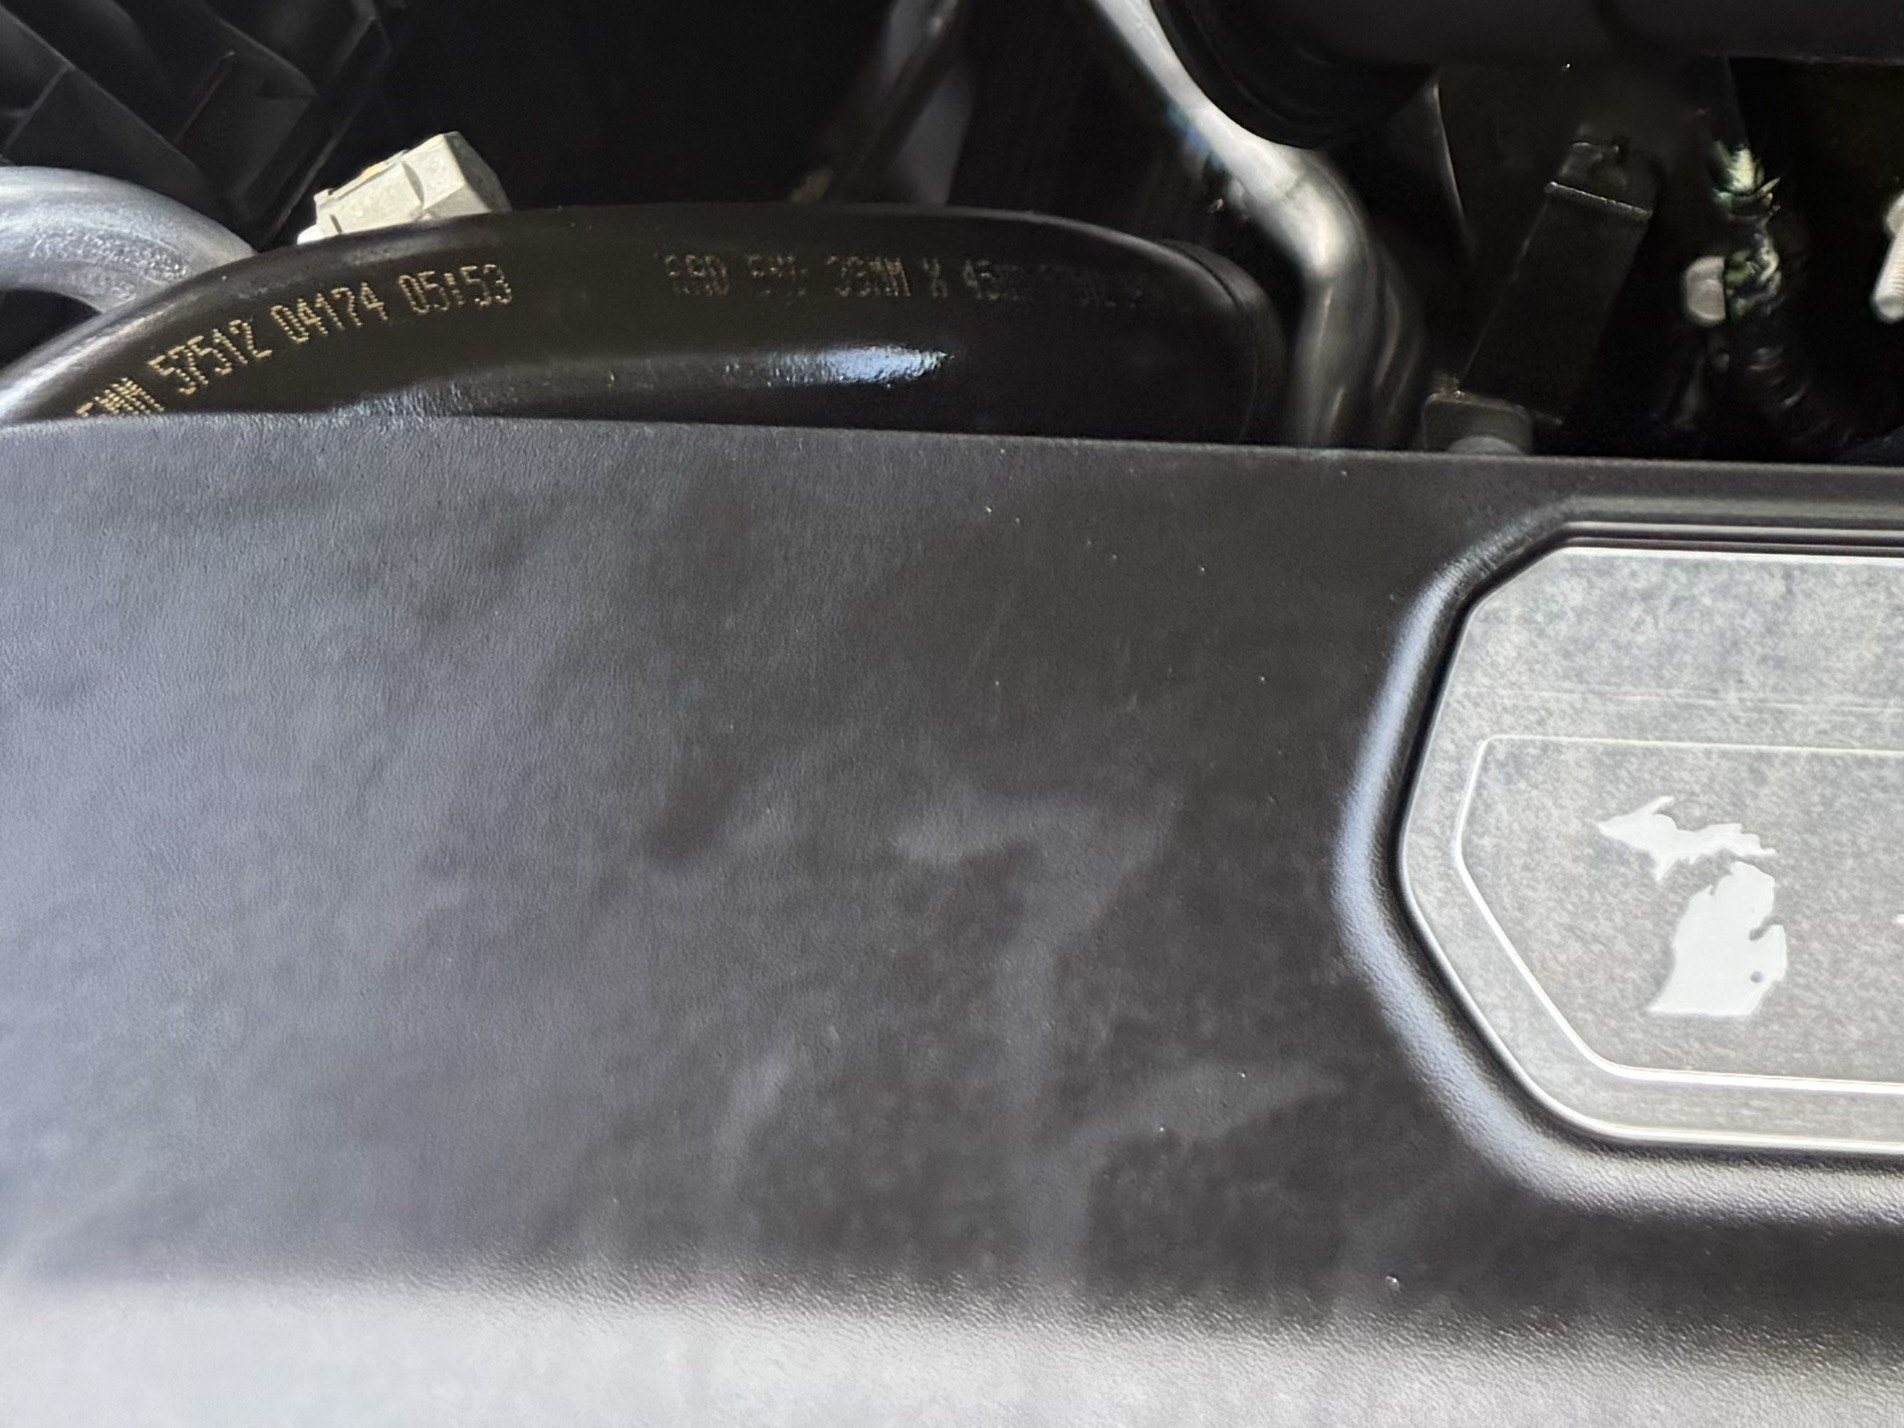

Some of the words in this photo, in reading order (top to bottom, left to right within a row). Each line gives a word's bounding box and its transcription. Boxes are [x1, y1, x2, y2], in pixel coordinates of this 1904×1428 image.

[147, 318, 273, 396] 57512
[270, 281, 389, 344] 04174
[398, 263, 513, 316] 05:53
